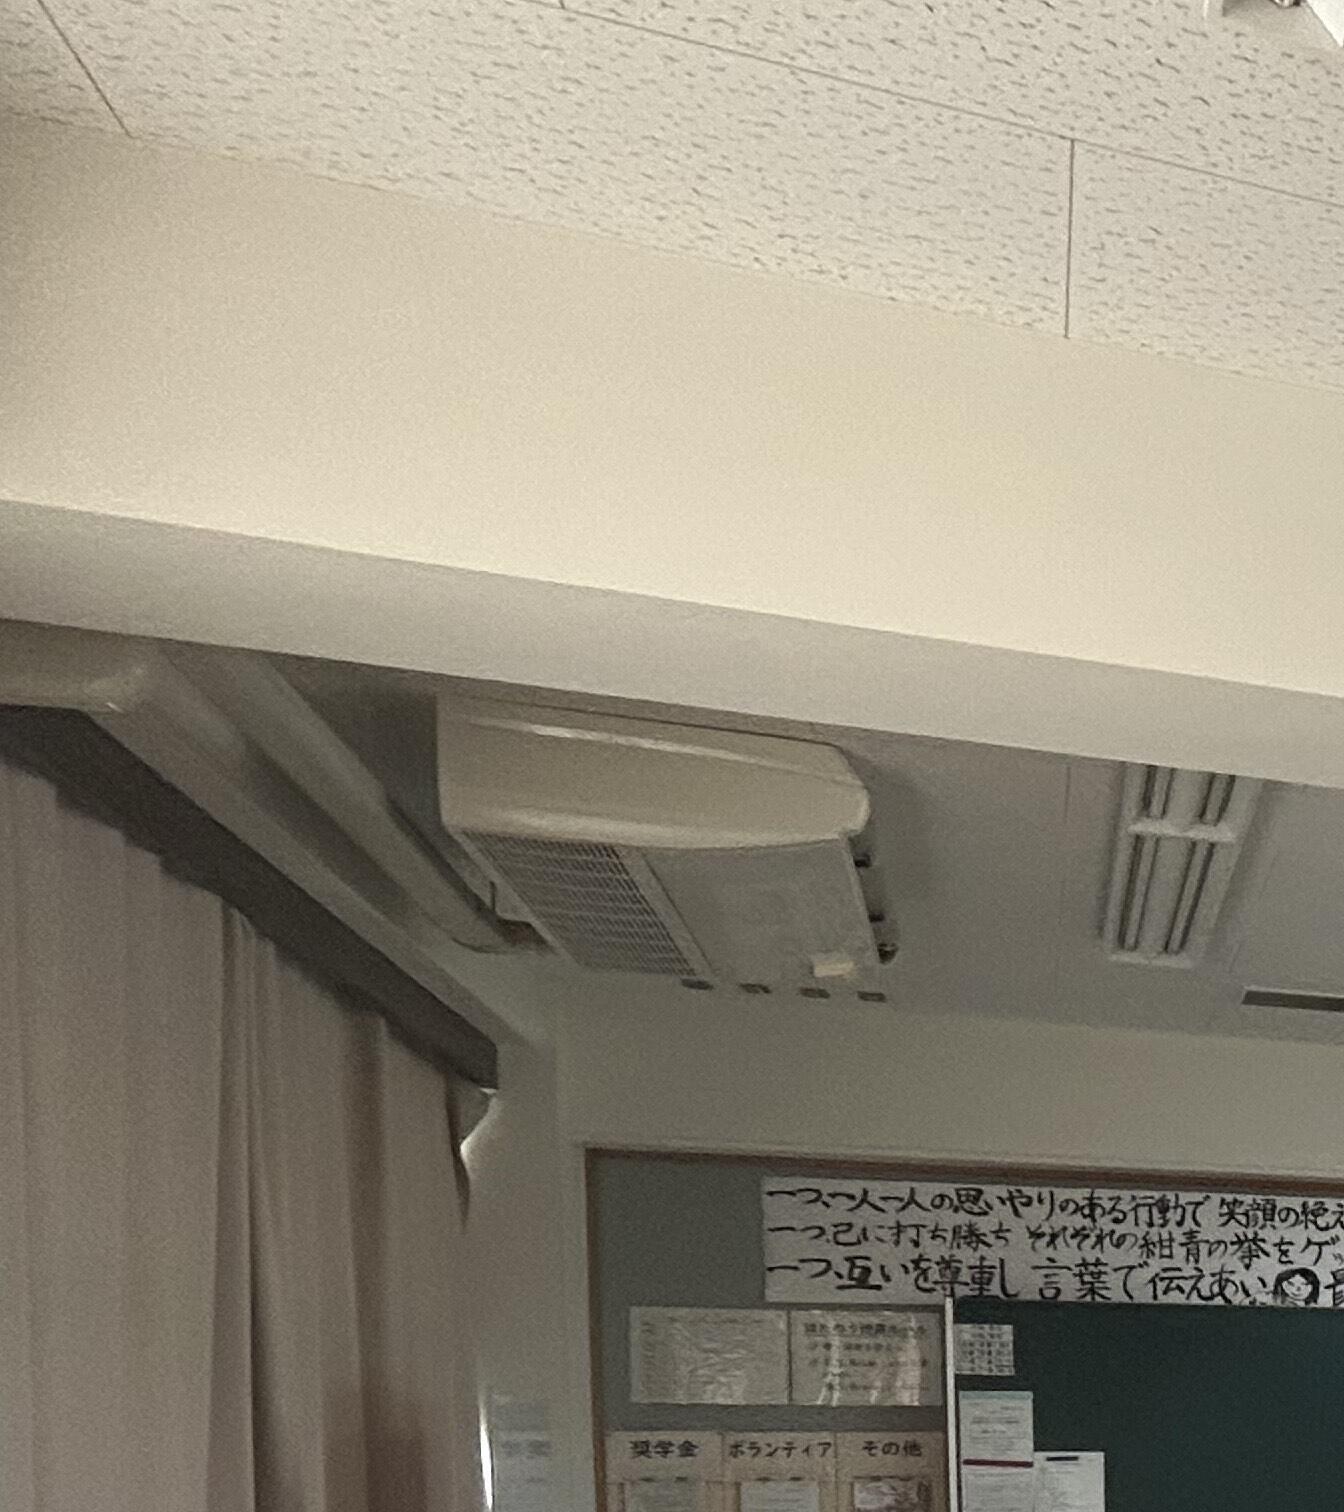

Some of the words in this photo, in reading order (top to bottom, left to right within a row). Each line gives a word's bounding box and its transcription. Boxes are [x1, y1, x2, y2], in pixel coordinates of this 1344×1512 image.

[629, 1439, 699, 1459] 奨学金
[729, 1441, 833, 1458] ボランティア
[861, 1440, 923, 1457] その他
